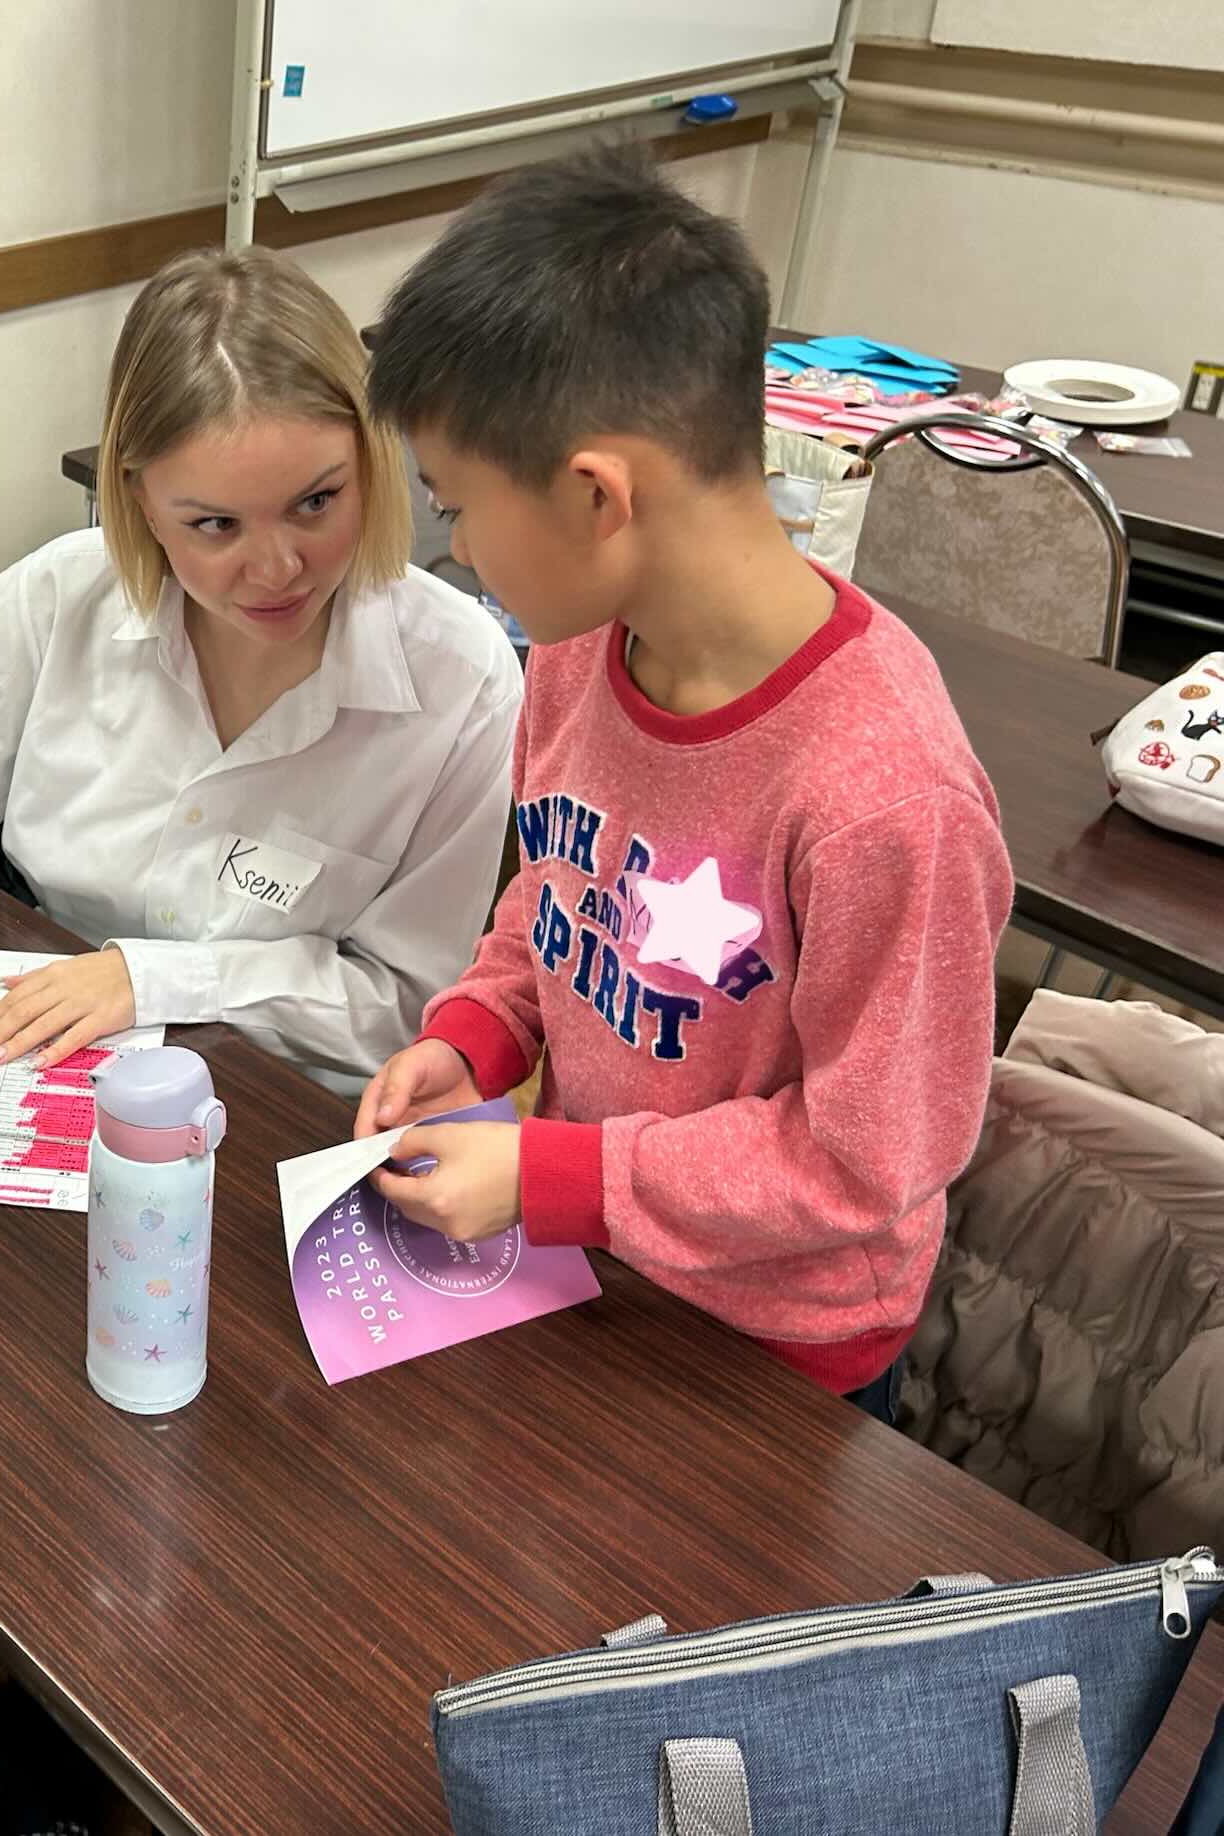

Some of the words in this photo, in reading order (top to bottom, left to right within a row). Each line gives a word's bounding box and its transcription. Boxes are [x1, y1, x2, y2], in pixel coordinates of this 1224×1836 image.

[516, 793, 606, 877] WITH
[576, 886, 624, 943] AND
[532, 881, 705, 1061] SPIRIT
[332, 1198, 346, 1240] TRI
[348, 1188, 405, 1322] PASSPORT
[315, 1235, 343, 1300] 2023
[339, 1253, 388, 1344] WORLD
